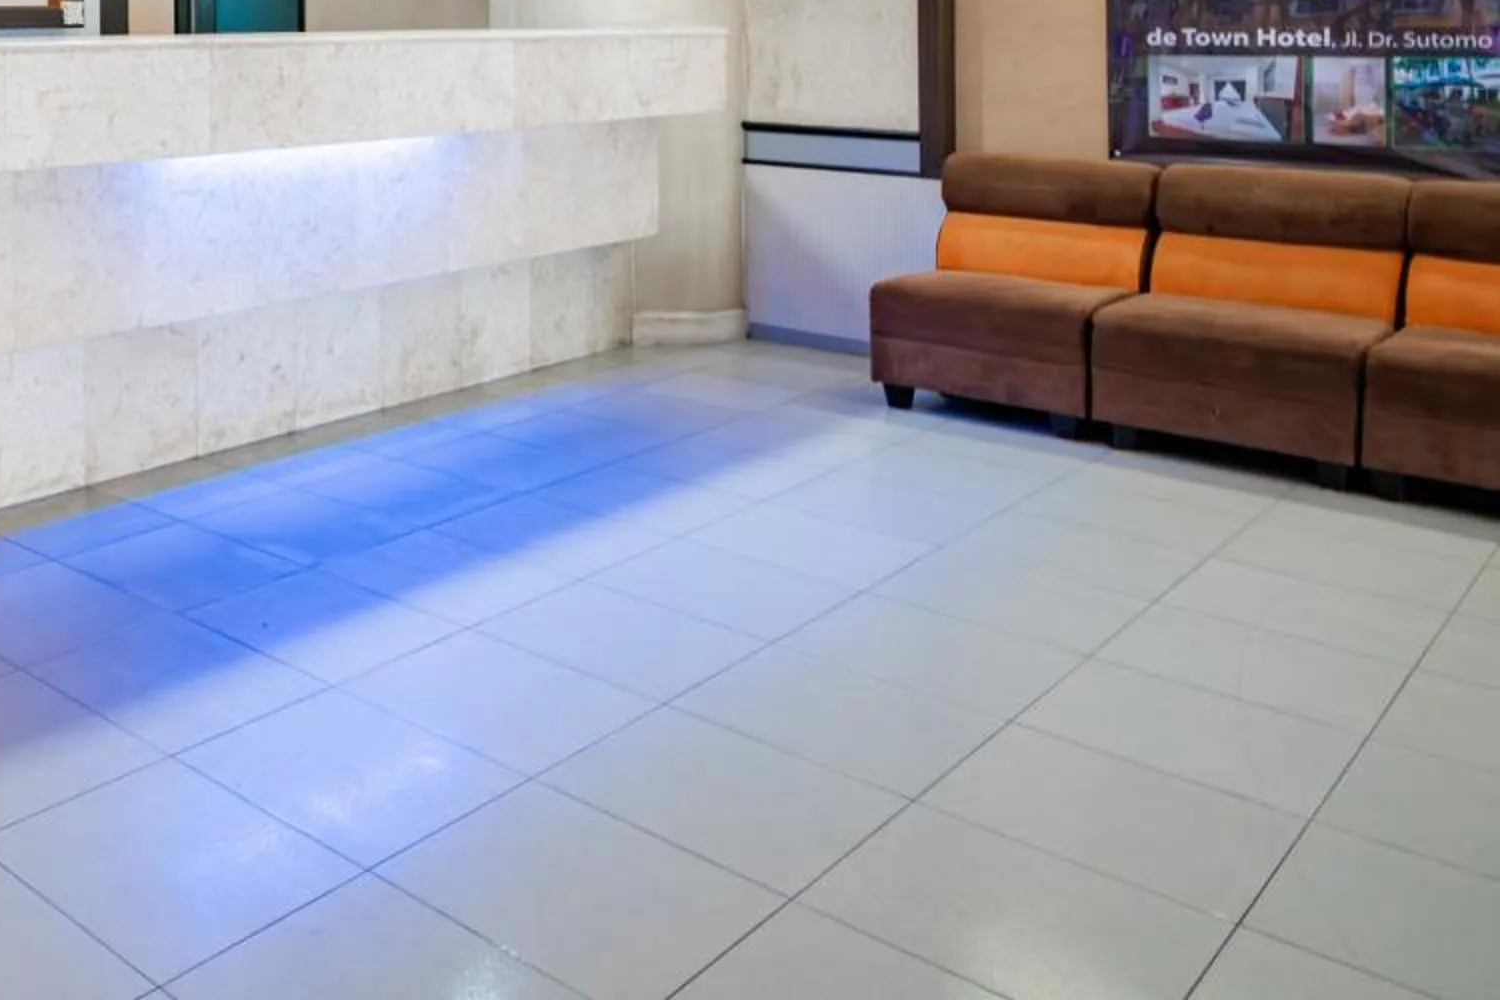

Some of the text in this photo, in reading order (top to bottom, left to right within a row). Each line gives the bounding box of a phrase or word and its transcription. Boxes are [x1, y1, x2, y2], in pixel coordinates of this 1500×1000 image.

[1147, 26, 1493, 49] de Town Hotel, Jl. Dr. Sutomo
